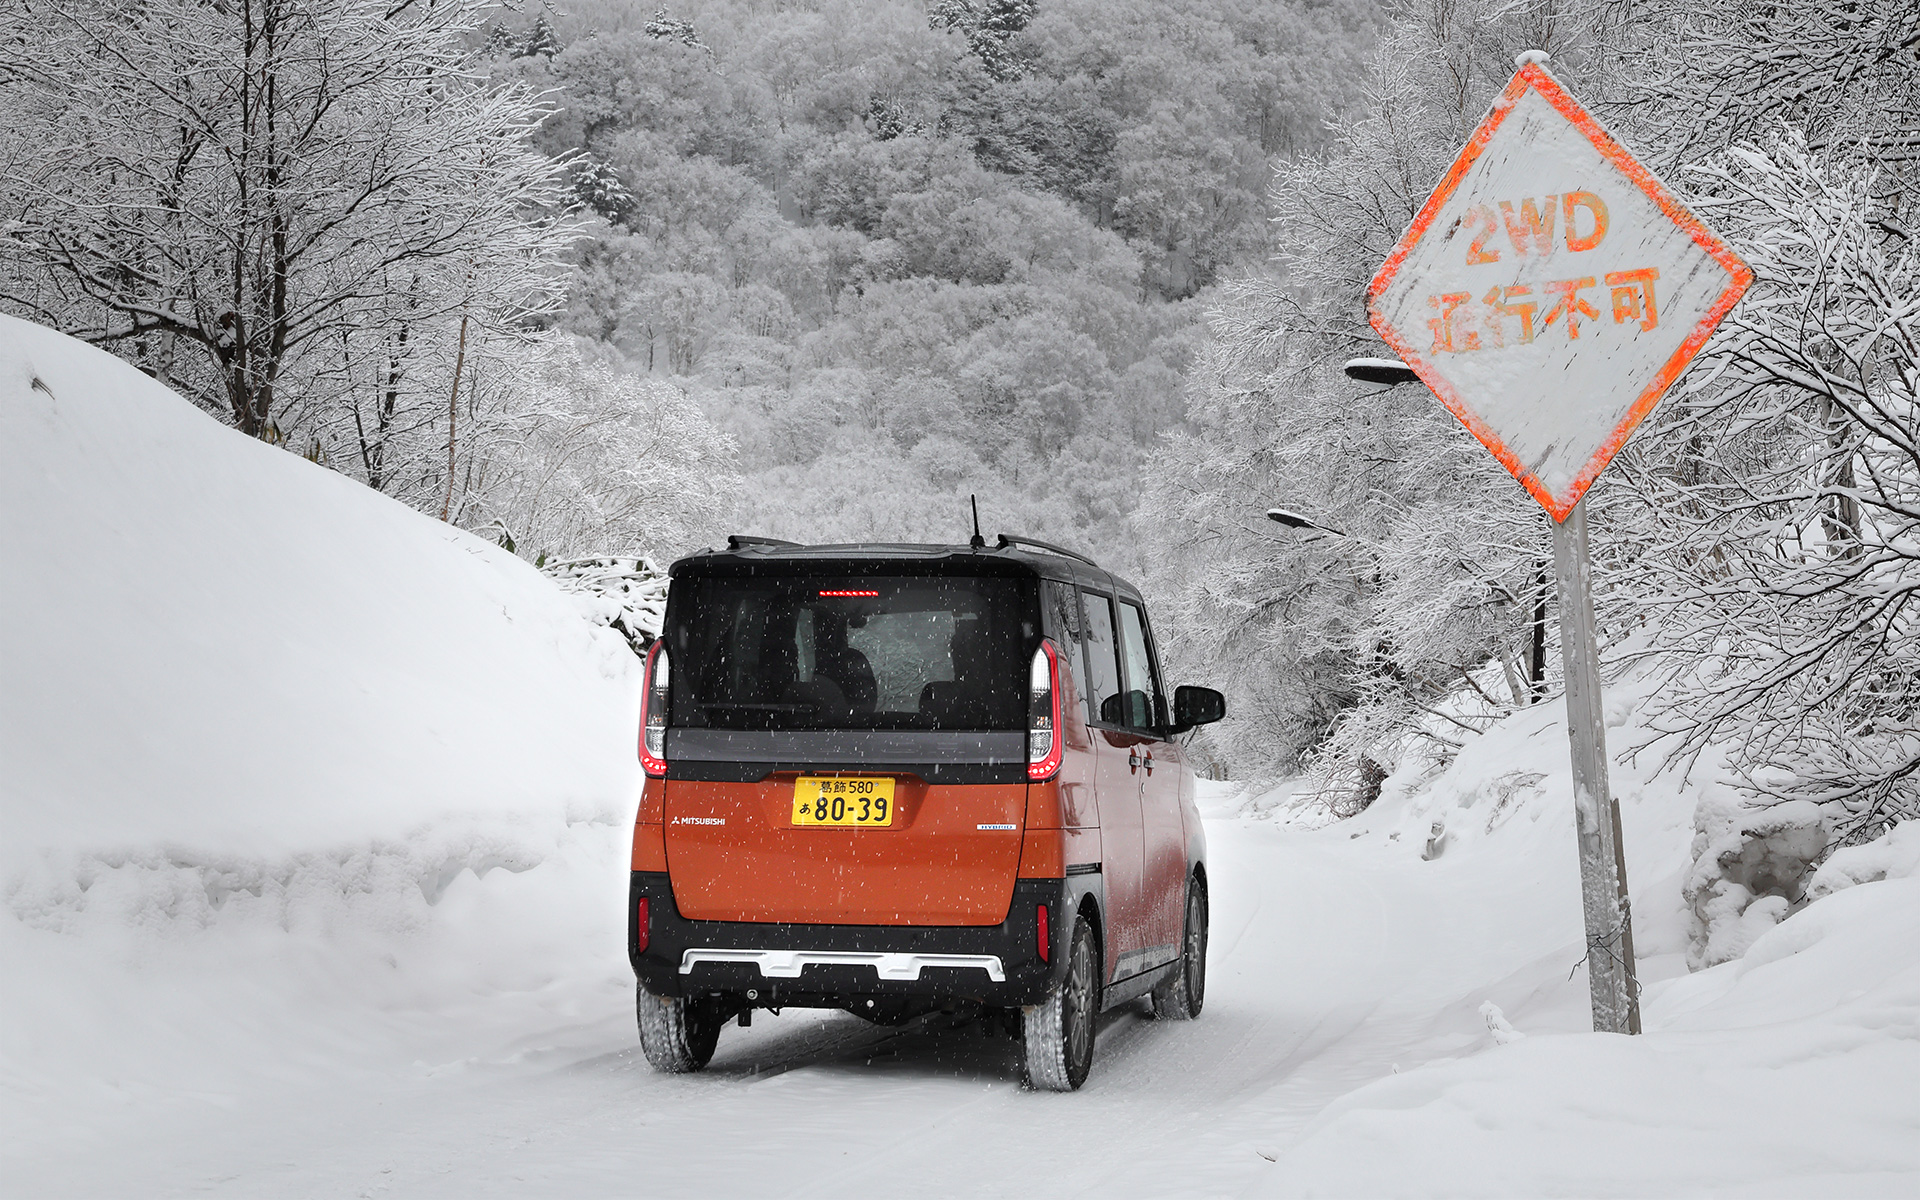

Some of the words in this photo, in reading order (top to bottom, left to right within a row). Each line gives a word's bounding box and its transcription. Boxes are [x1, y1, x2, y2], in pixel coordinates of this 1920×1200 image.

[1462, 190, 1610, 266] 2WD
[820, 781, 846, 794] 葛飾
[849, 781, 874, 794] 580
[799, 803, 811, 815] あ
[815, 797, 888, 822] 80-39
[681, 817, 726, 826] MITSUBISHI
